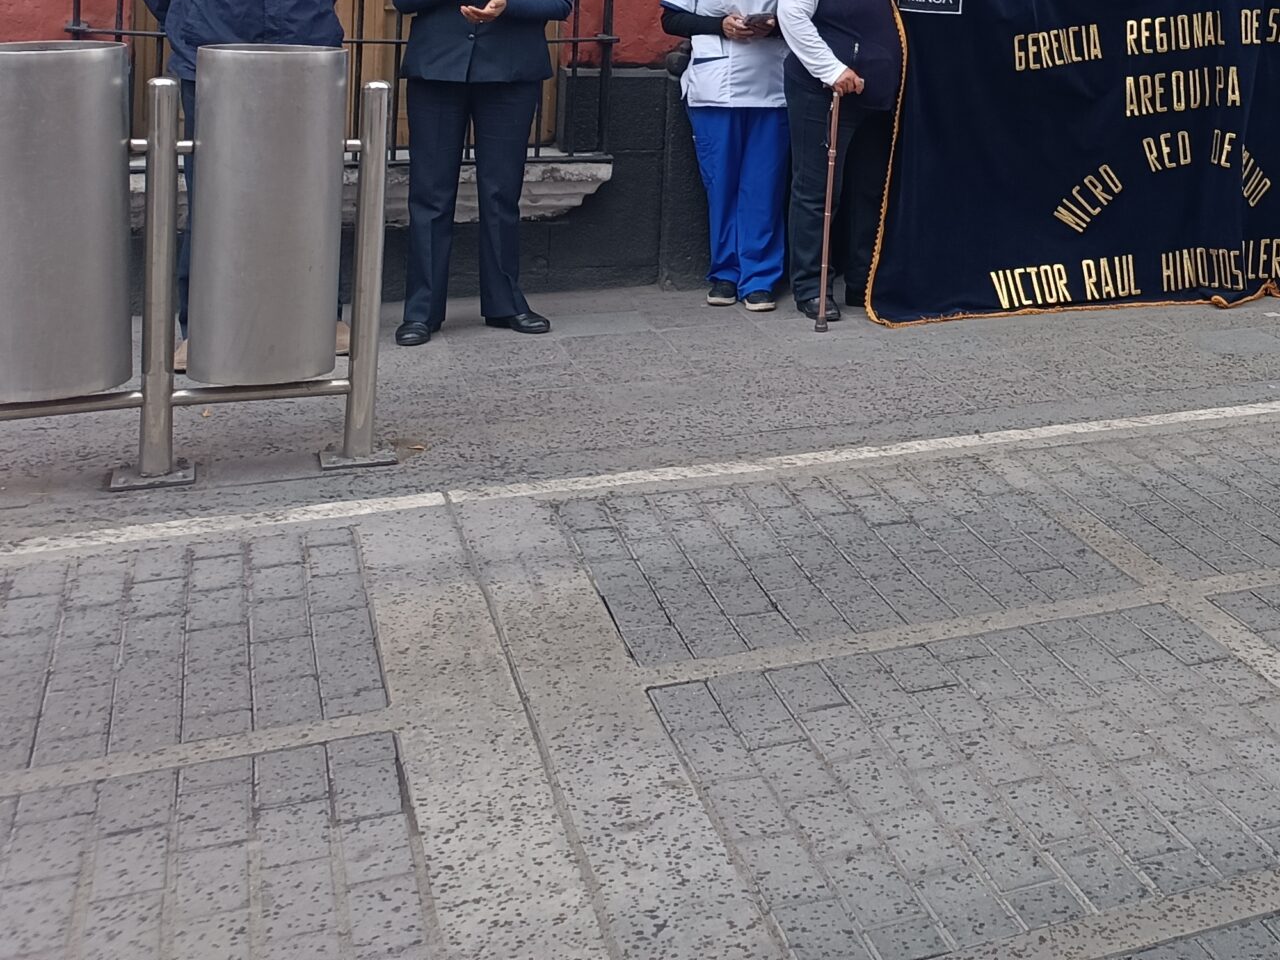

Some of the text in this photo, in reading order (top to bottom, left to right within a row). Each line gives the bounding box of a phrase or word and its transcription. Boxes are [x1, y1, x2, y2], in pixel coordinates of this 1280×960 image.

[1013, 23, 1102, 71] GERENCIA
[1126, 10, 1225, 55] REGIONAL
[1241, 9, 1261, 45] DE
[1125, 66, 1241, 117] AREQUIPA
[1053, 164, 1123, 233] MICRO
[1142, 130, 1191, 172] RED
[1210, 129, 1236, 168] DE
[990, 263, 1072, 309] VICTOR
[1081, 254, 1141, 300] RAUL
